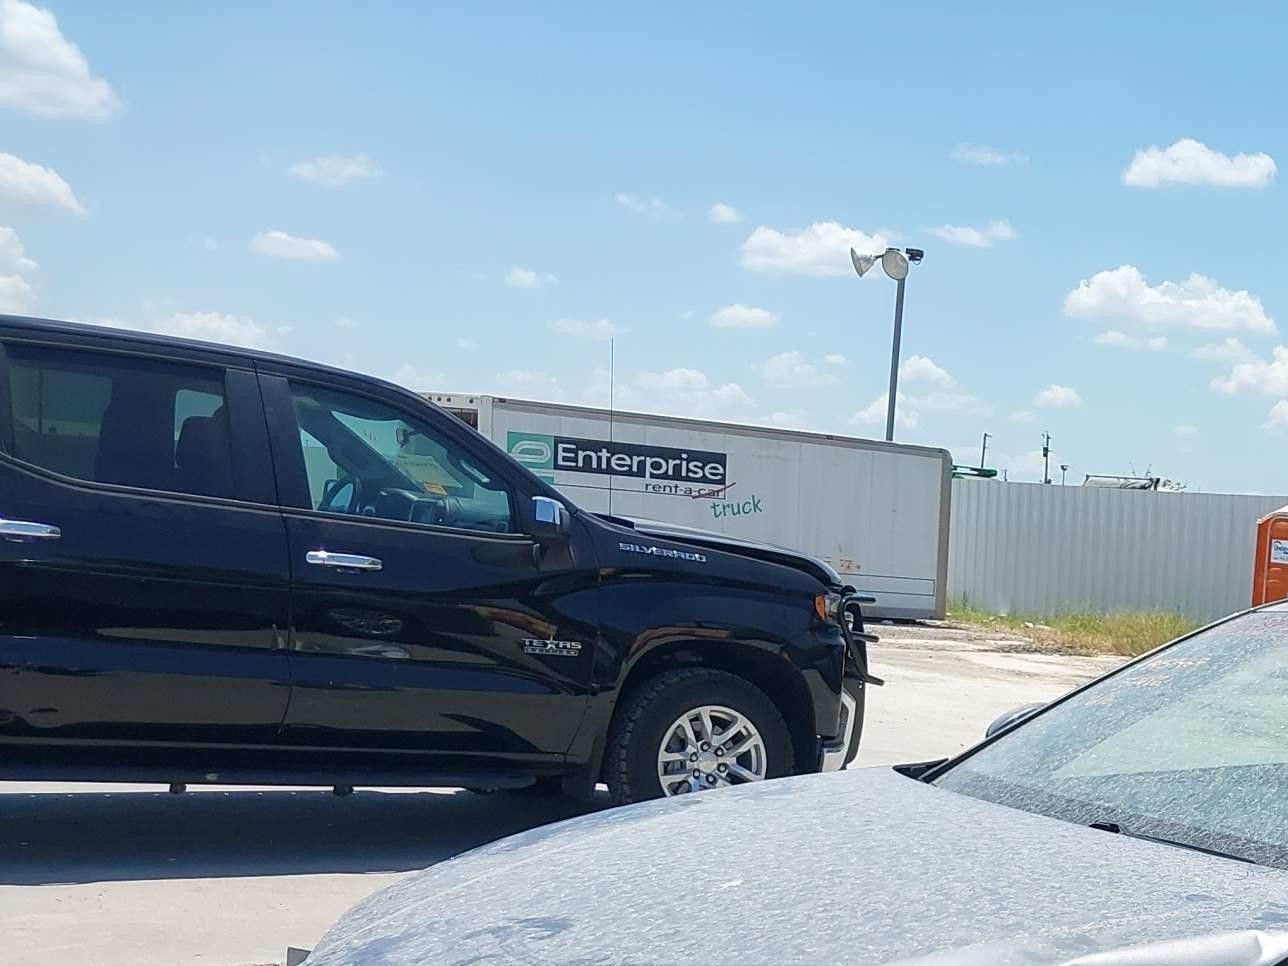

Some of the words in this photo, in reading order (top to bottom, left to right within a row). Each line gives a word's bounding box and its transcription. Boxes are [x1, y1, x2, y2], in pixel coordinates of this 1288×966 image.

[557, 443, 725, 480] Enterprise
[645, 482, 724, 498] rent-a-car
[710, 495, 763, 519] truck
[618, 543, 708, 562] SILVERADO
[521, 637, 583, 649] TEXAS
